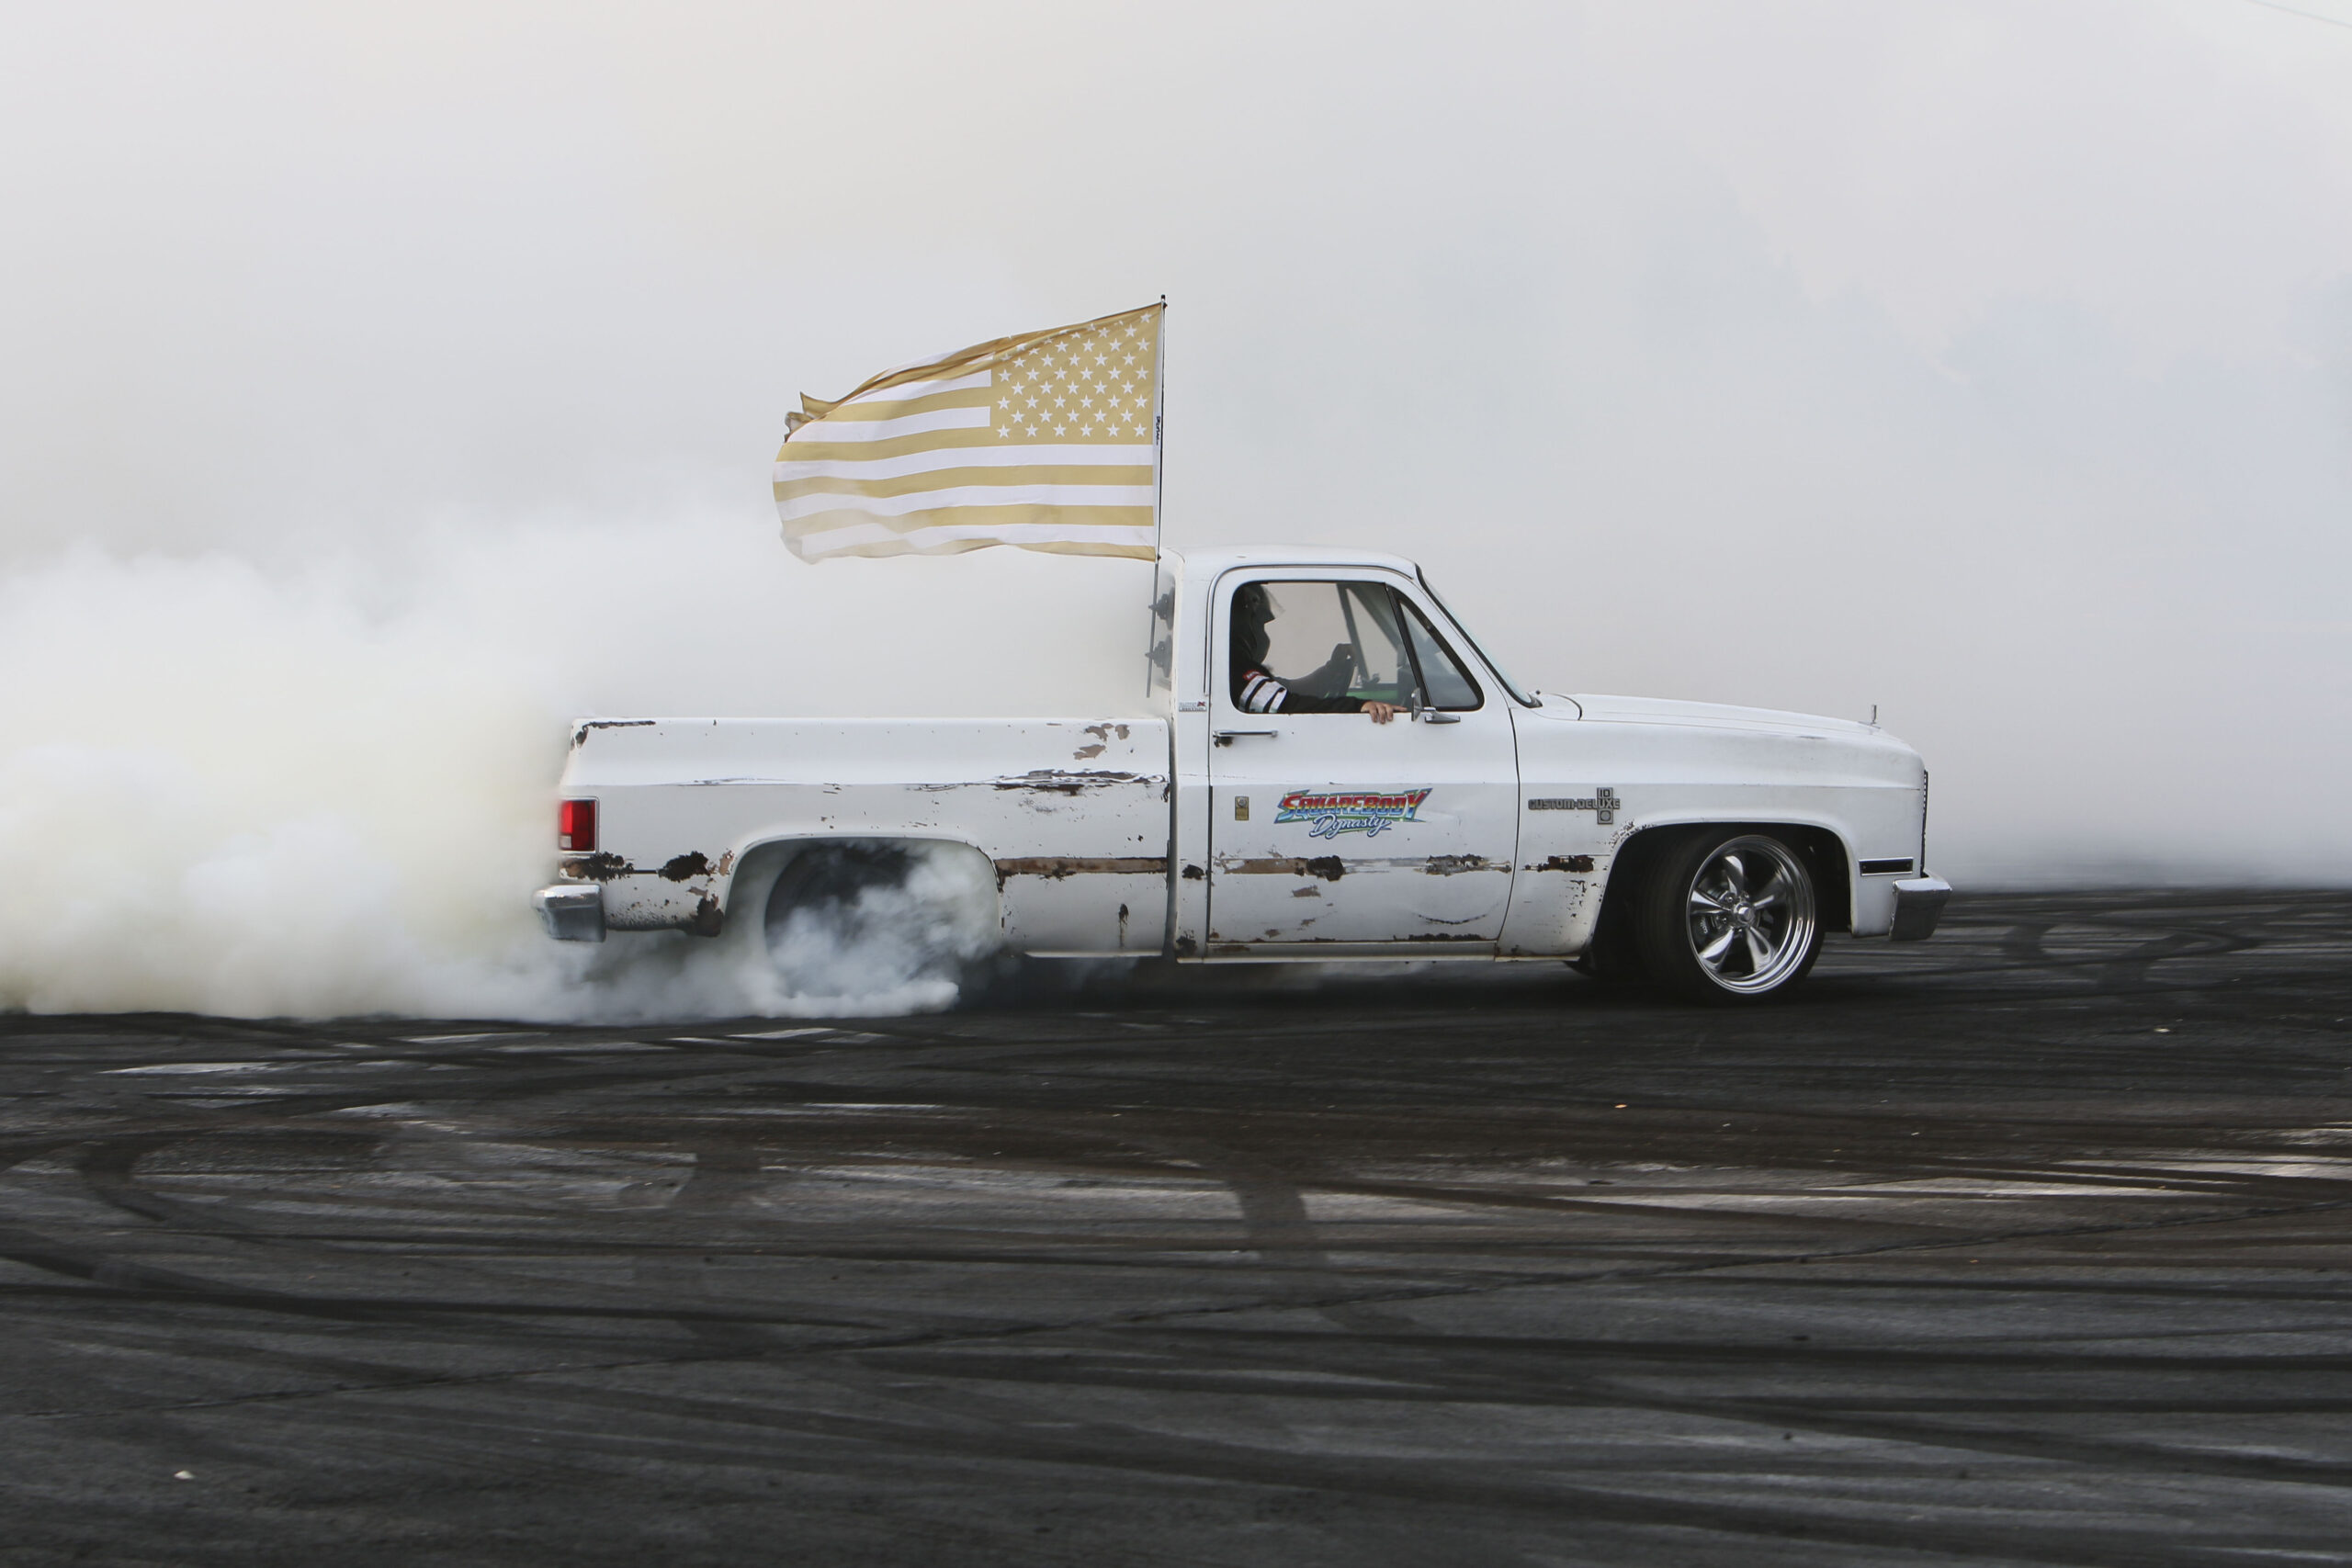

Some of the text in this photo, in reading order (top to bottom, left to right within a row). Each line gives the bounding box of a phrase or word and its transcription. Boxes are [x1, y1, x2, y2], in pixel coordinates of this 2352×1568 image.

[1275, 789, 1431, 823] SQUAREBODY
[1600, 789, 1611, 797] 10
[1309, 813, 1392, 839] Dynasty
